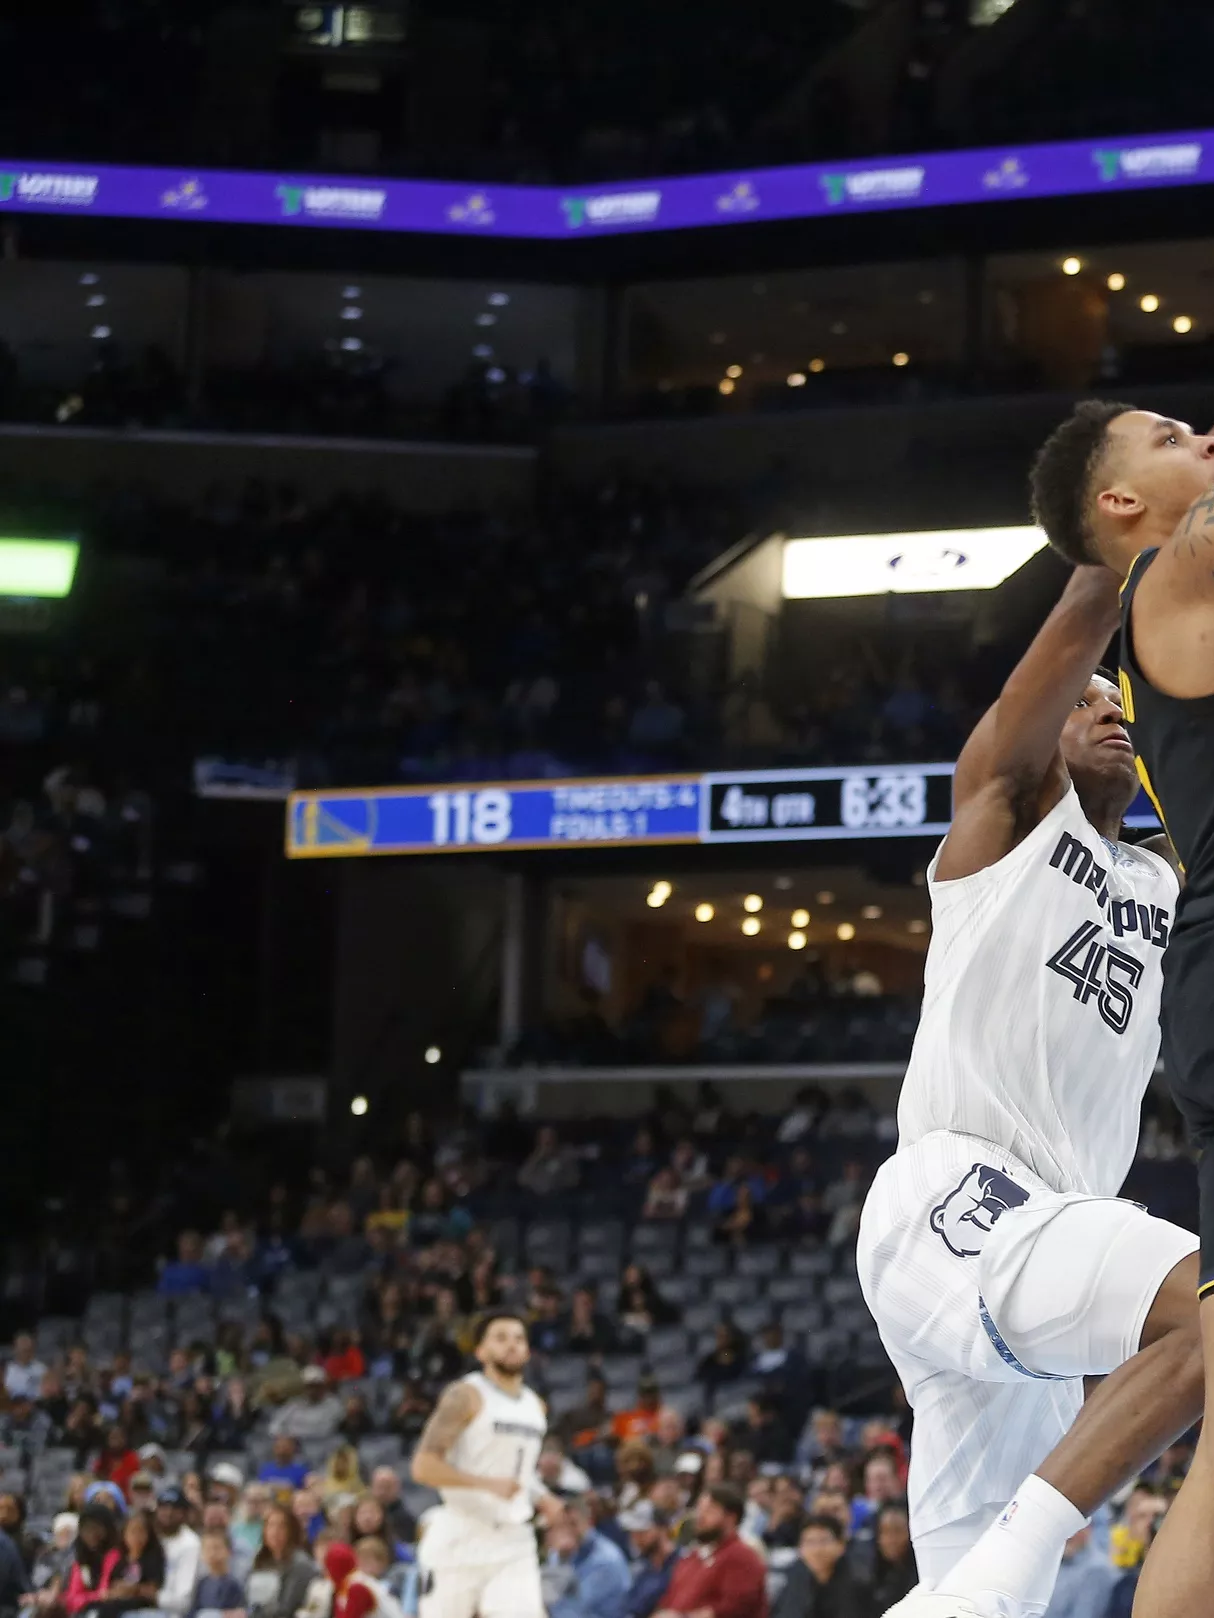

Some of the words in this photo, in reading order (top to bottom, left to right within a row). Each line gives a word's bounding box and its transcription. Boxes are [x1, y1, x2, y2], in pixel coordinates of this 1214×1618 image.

[18, 172, 99, 198] LOTTERY
[428, 788, 512, 846] 118
[841, 773, 927, 829] 6:33
[1045, 919, 1145, 1034] 45
